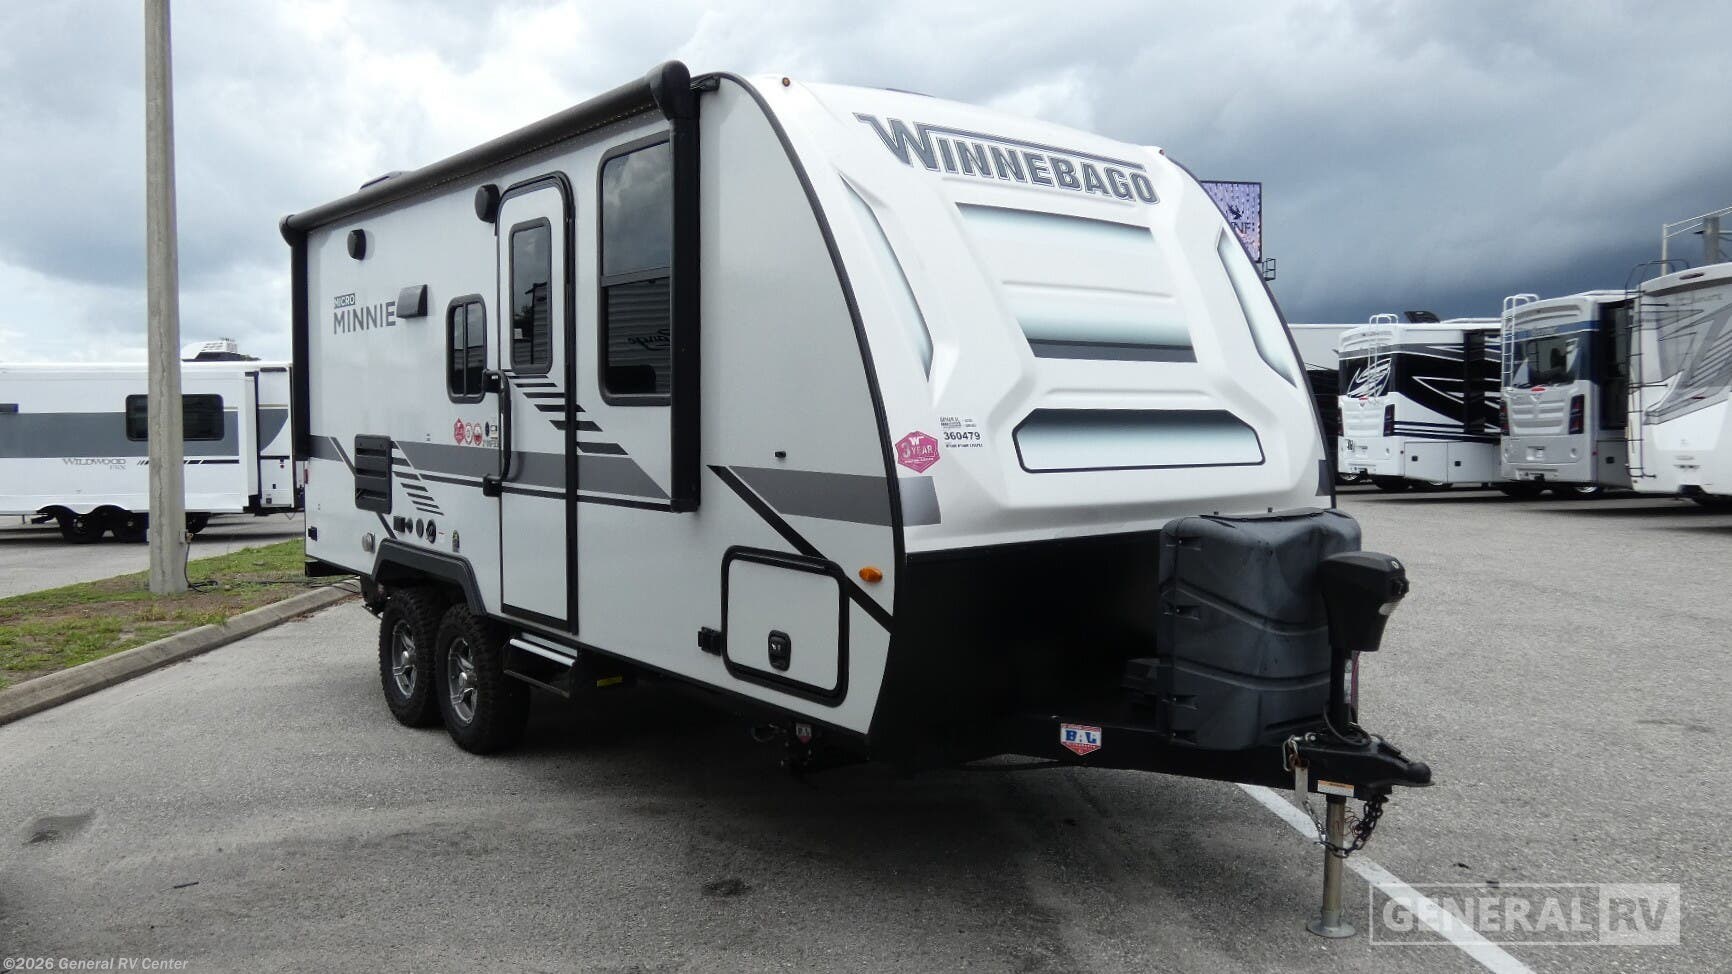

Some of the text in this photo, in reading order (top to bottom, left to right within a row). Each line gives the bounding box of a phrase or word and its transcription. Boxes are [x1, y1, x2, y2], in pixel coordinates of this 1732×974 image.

[853, 112, 1161, 205] WINNEBAGO
[334, 294, 355, 308] MICRO
[333, 301, 397, 335] MINNIE
[943, 431, 981, 441] 360479
[911, 445, 933, 455] YEAR
